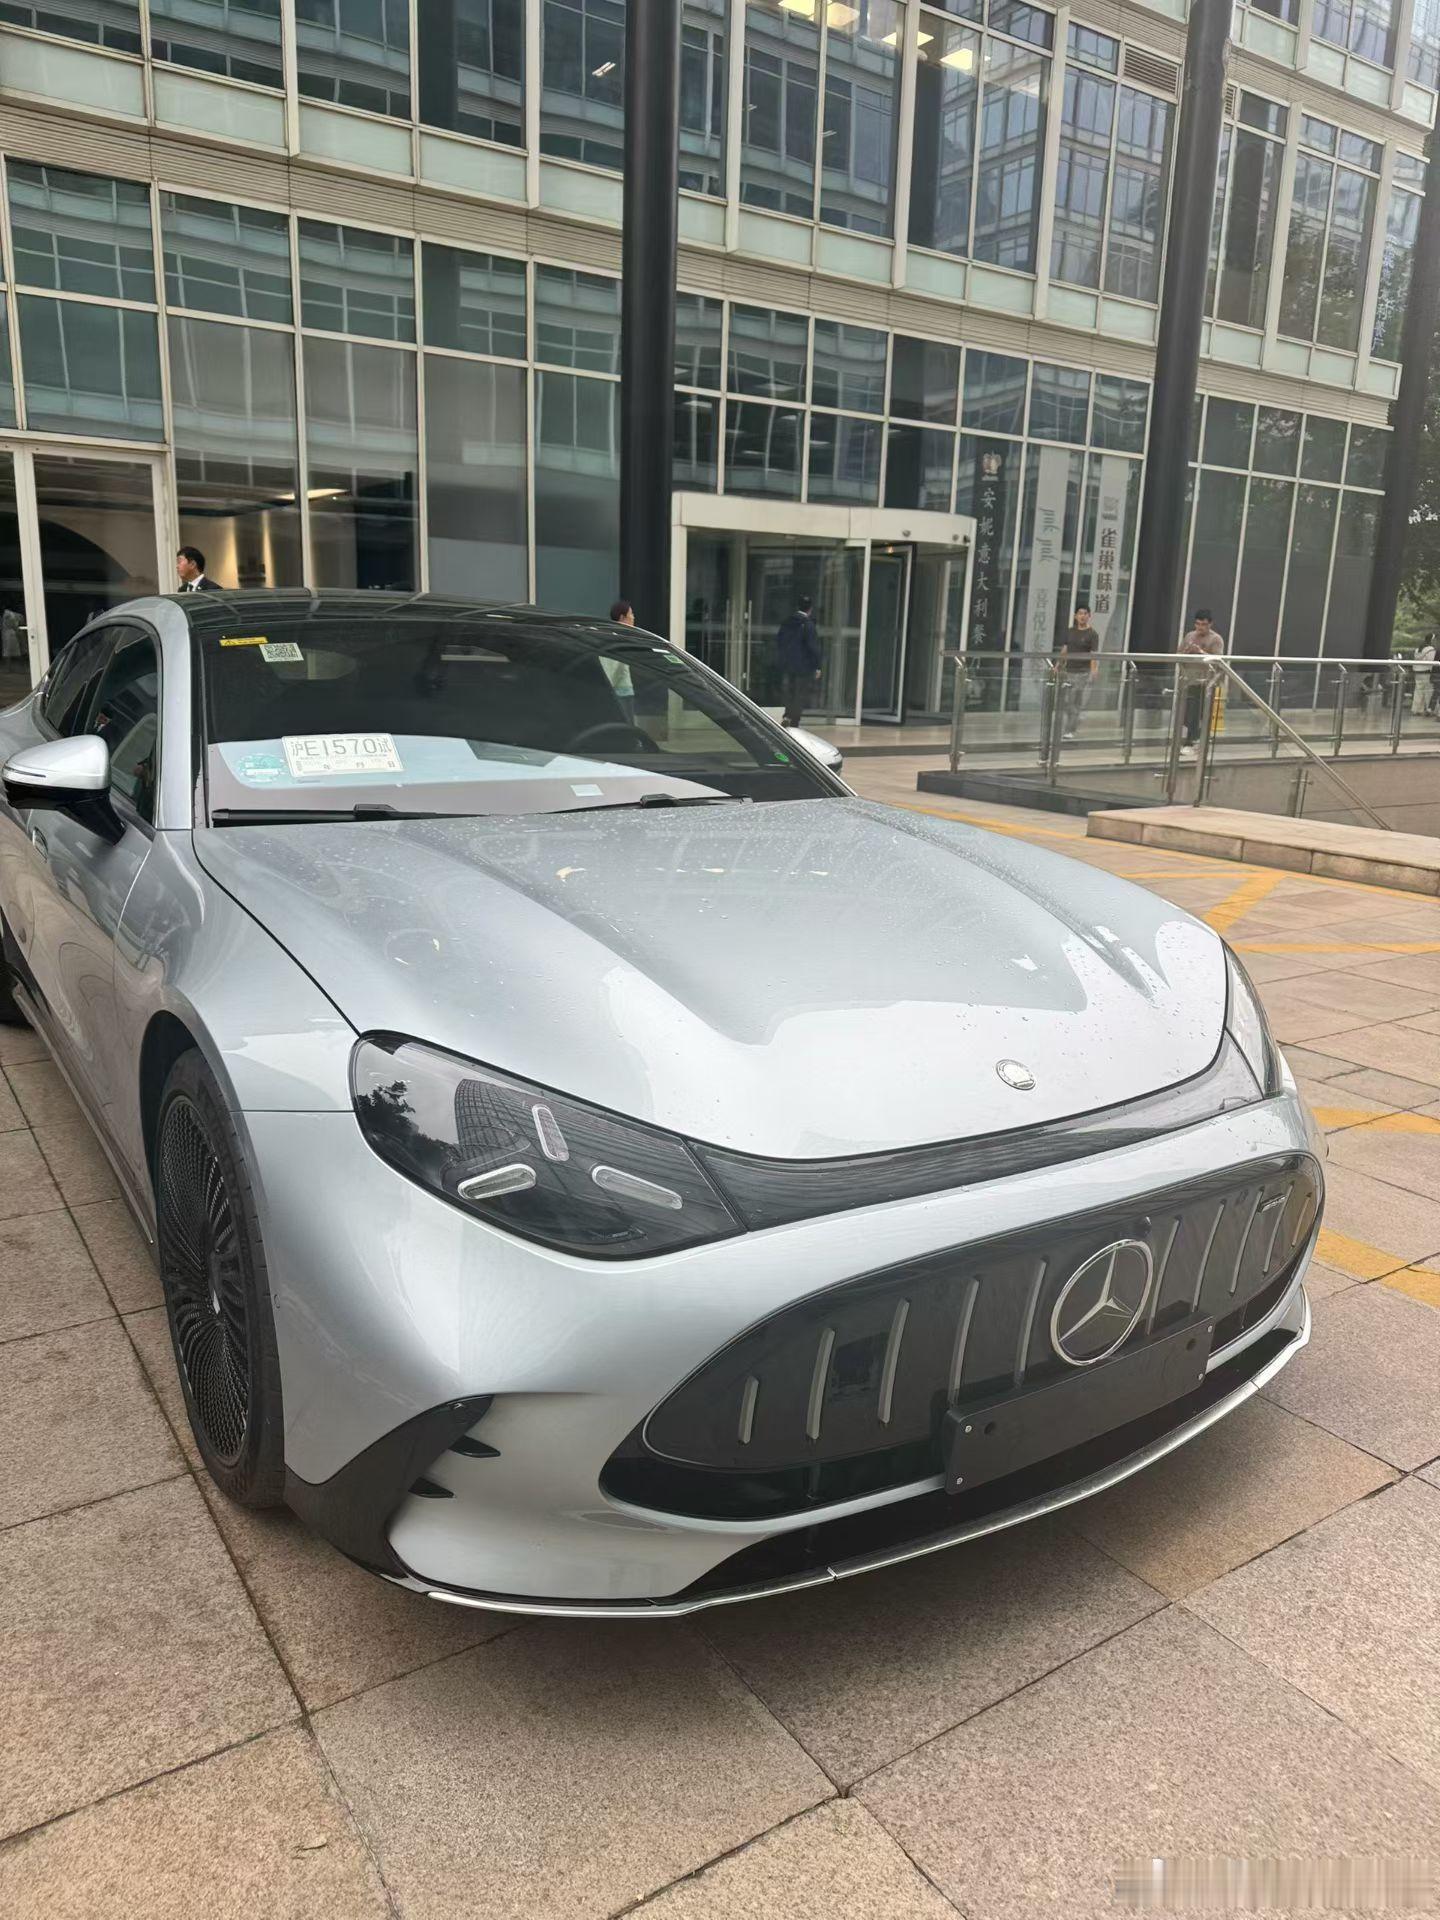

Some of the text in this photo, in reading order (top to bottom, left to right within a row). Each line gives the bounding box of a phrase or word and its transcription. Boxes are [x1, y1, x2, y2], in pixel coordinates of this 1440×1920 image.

[1094, 527, 1118, 614] 雀巢味道
[290, 737, 393, 757] 沪E1570试
